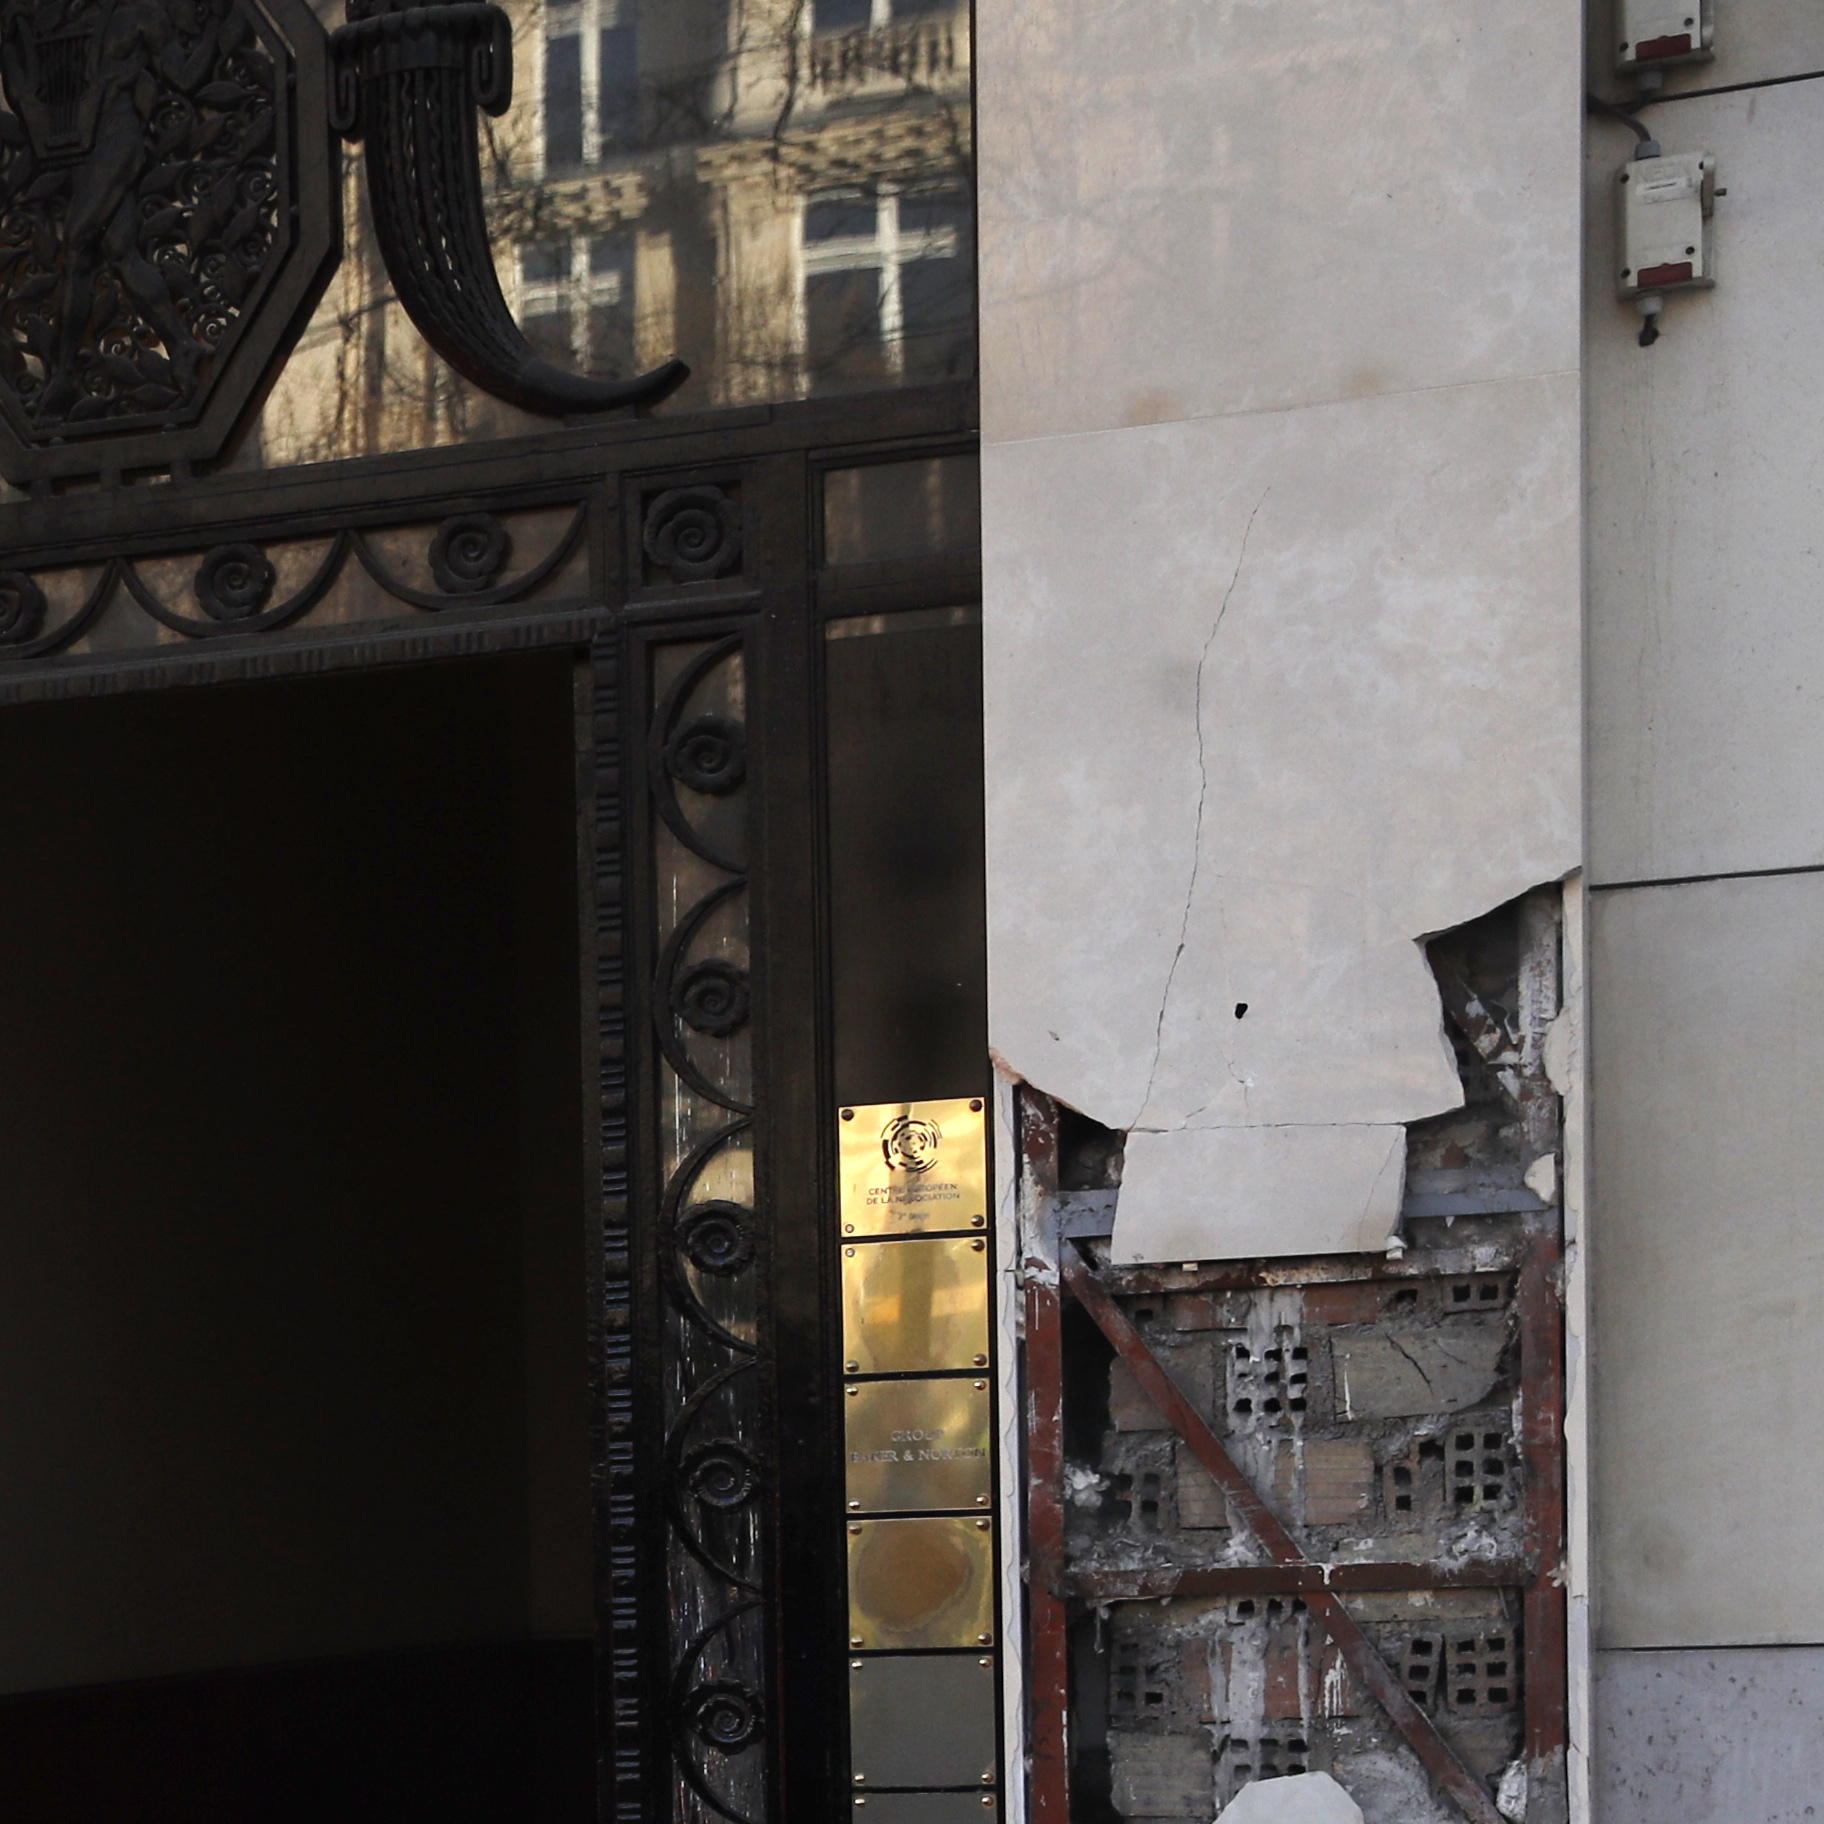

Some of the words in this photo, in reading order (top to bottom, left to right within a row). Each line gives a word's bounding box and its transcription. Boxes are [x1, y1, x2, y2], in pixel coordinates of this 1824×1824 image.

[868, 1186, 903, 1196] CENTRE
[866, 1197, 878, 1205] DE
[890, 1428, 945, 1443] GROUP
[852, 1450, 898, 1463] BAKER
[903, 1450, 914, 1462] &
